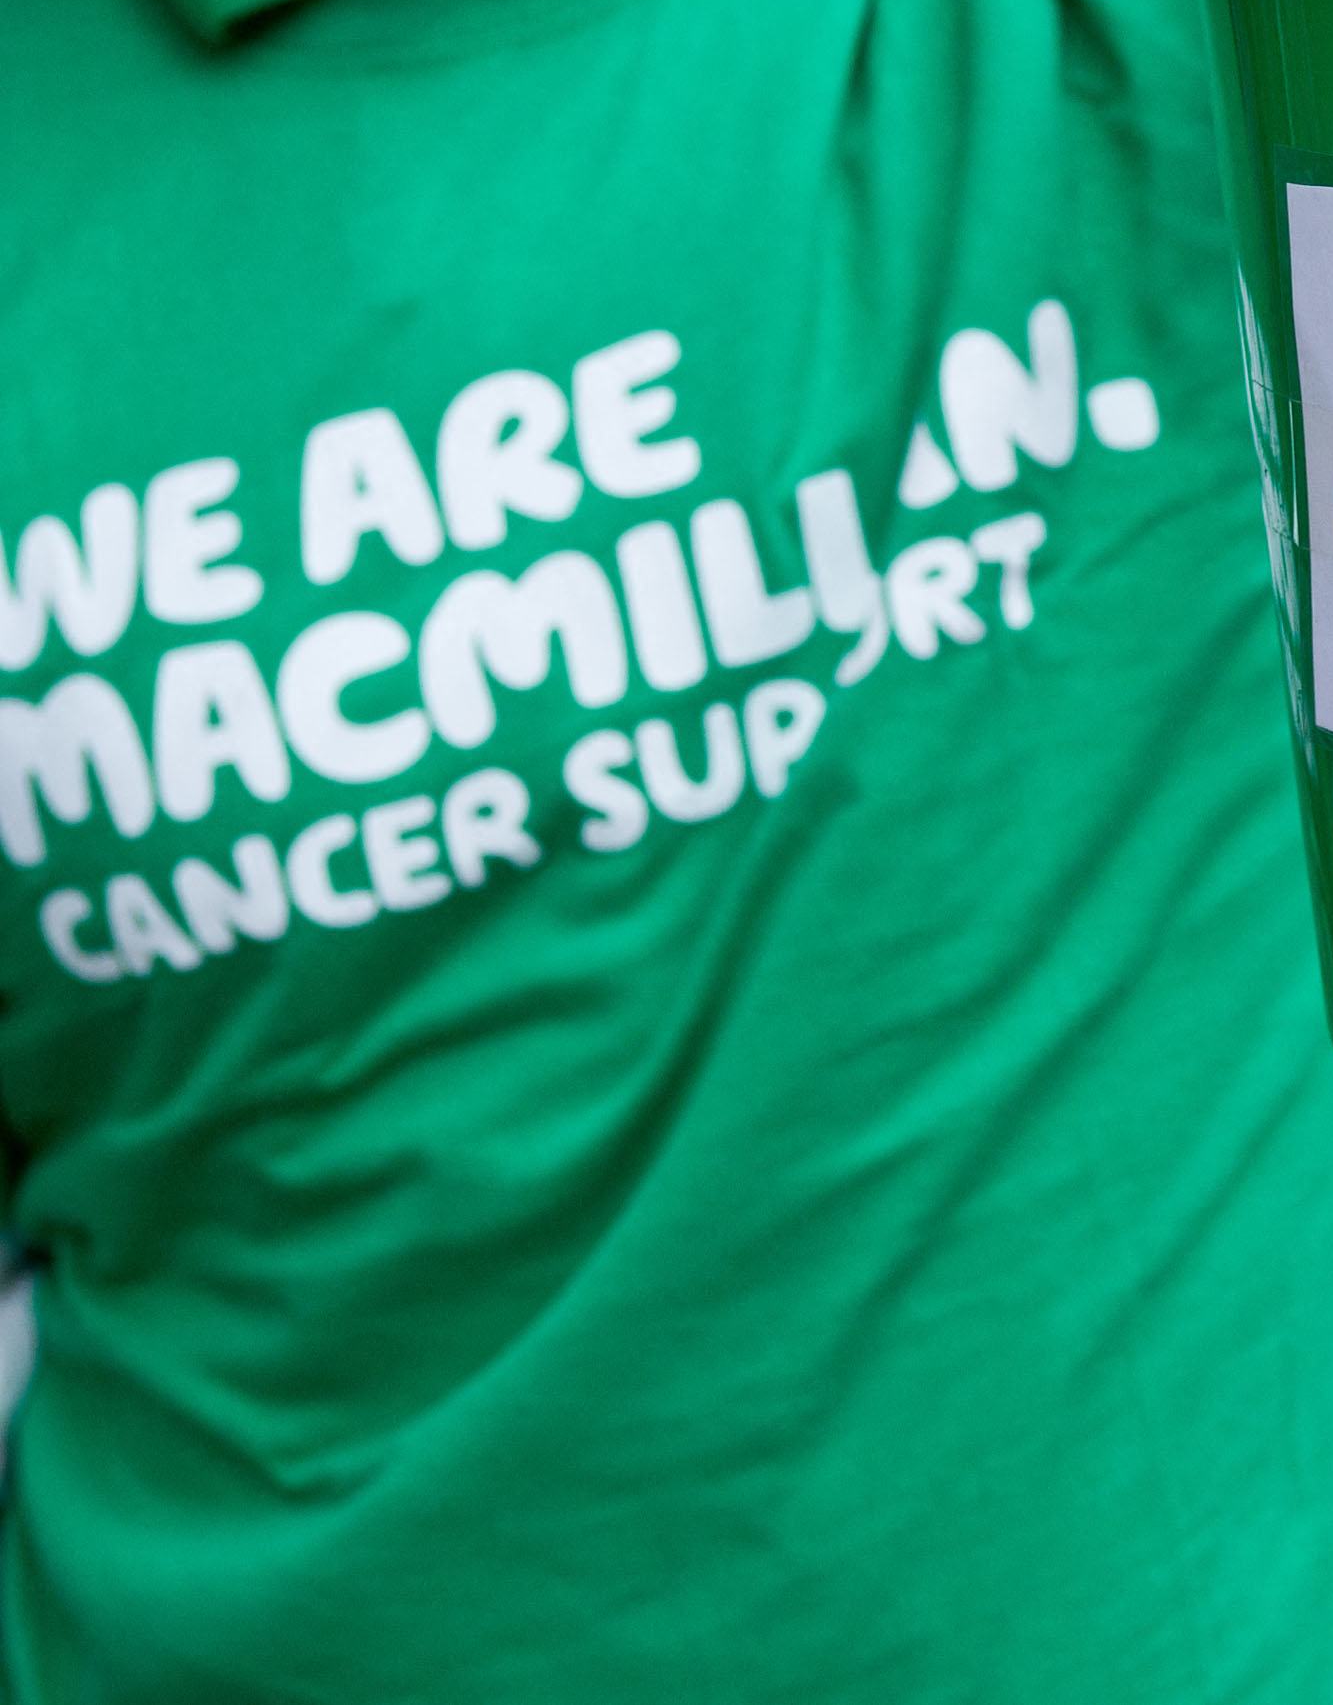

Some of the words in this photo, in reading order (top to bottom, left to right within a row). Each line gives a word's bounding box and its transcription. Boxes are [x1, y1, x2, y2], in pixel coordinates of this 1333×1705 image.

[0, 456, 264, 672] WE
[299, 329, 702, 586] ARE
[40, 767, 540, 983] CANCER
[562, 511, 1047, 852] SUPRT
